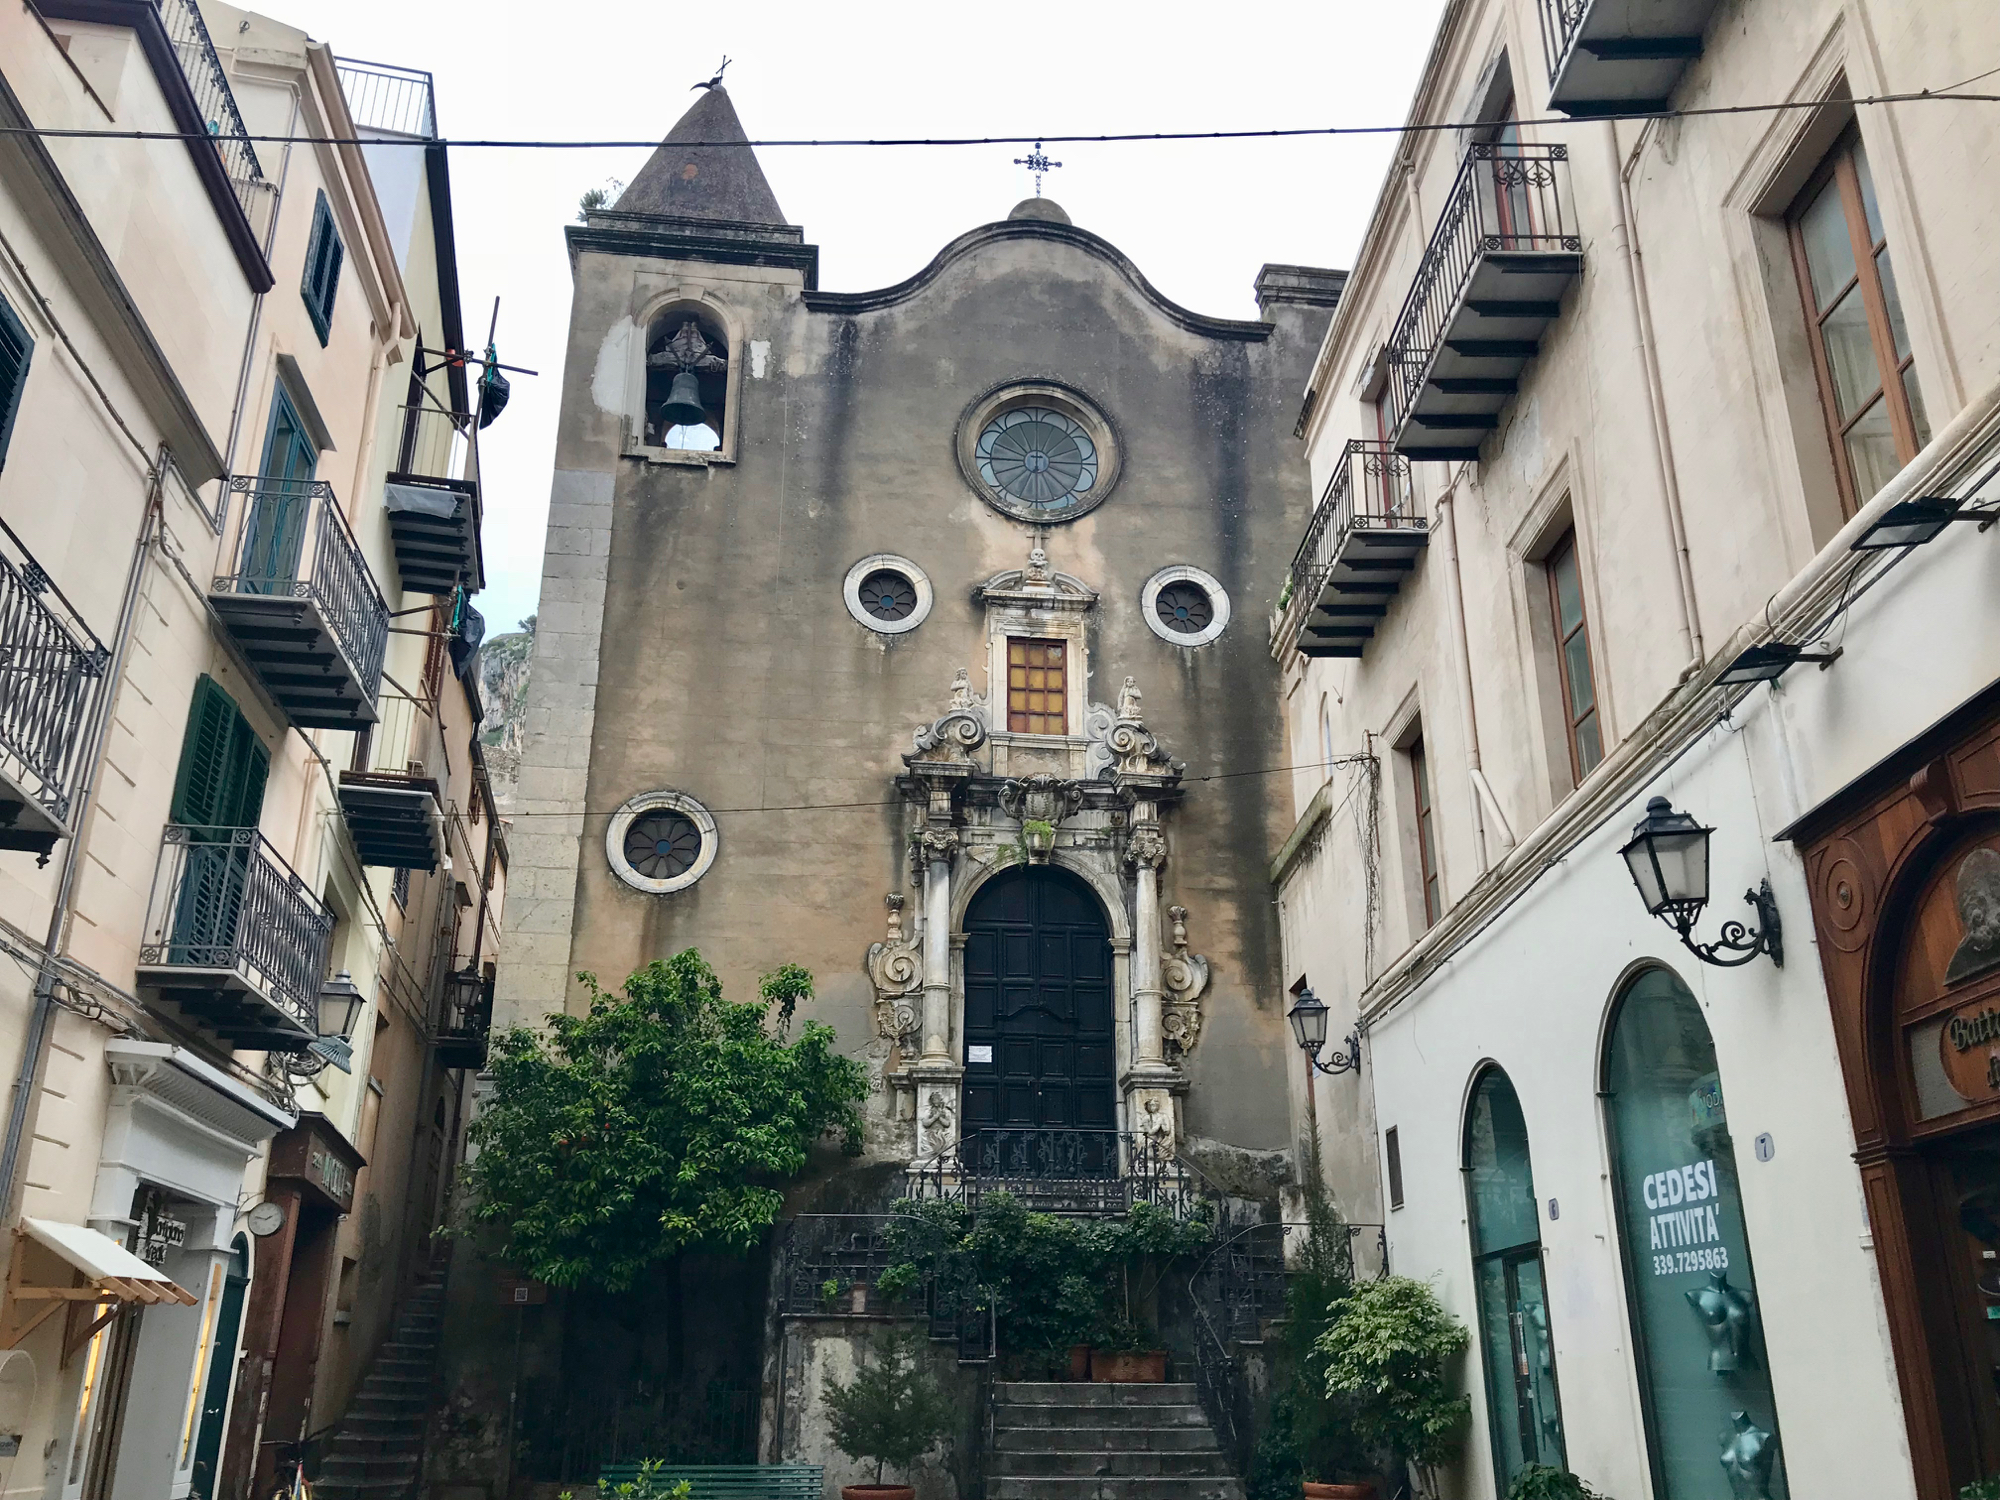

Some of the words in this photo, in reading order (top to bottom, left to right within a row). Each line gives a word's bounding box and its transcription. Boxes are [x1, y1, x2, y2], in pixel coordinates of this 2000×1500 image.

[1643, 1160, 1718, 1210] CEDESI
[1650, 1203, 1720, 1250] ATTIVITA'
[1653, 1247, 1729, 1276] 339.7295863
